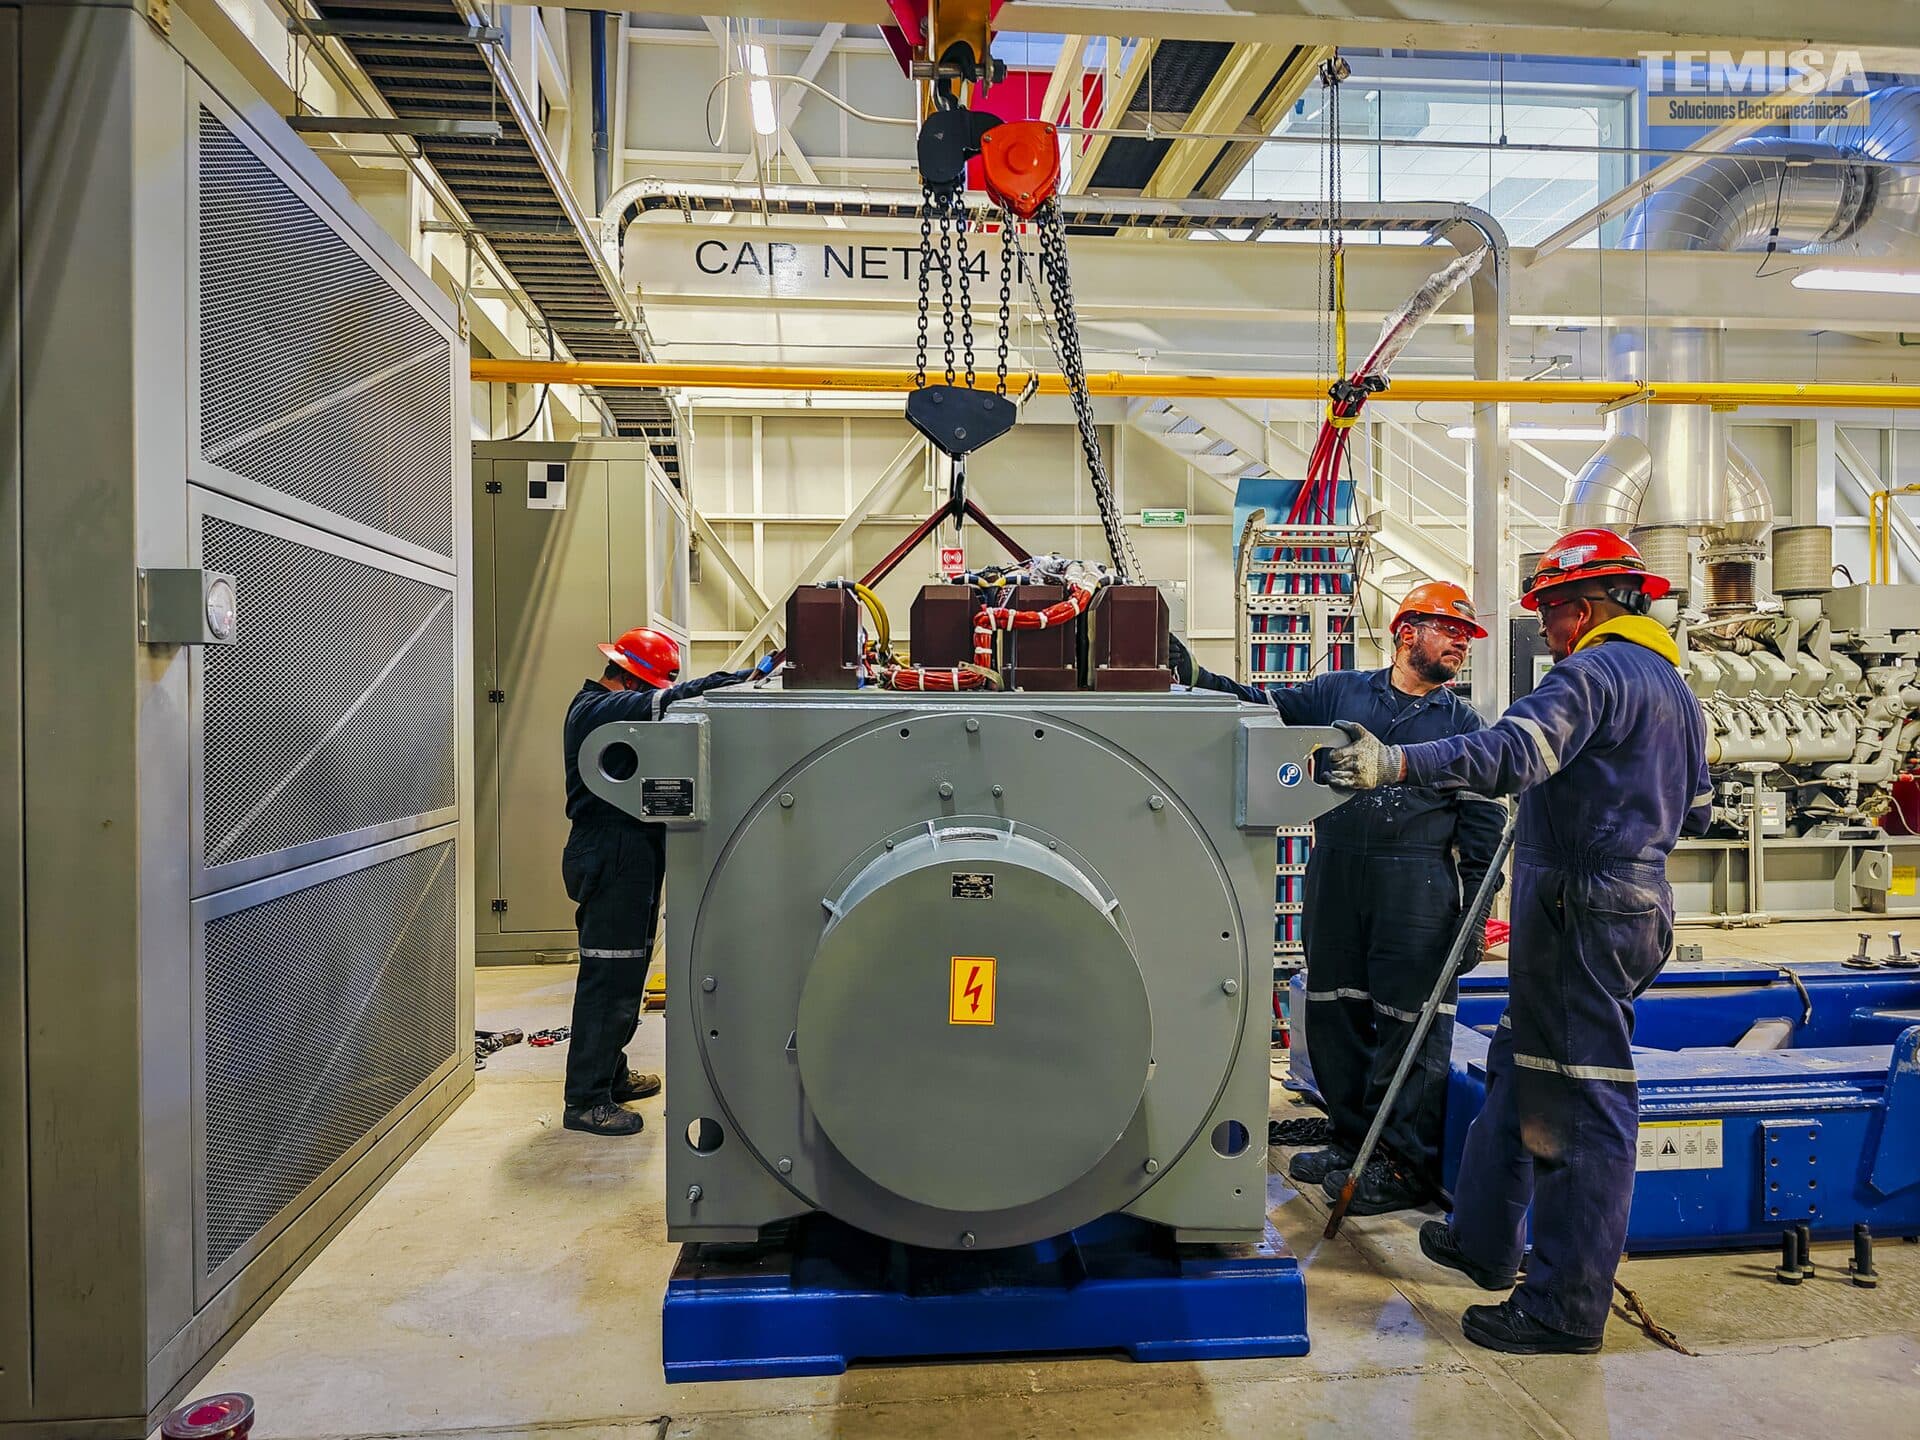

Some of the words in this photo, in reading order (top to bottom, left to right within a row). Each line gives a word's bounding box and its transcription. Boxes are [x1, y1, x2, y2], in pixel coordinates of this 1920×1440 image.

[695, 239, 803, 277] CAP.
[824, 245, 950, 281] NETA
[964, 249, 990, 282] 4
